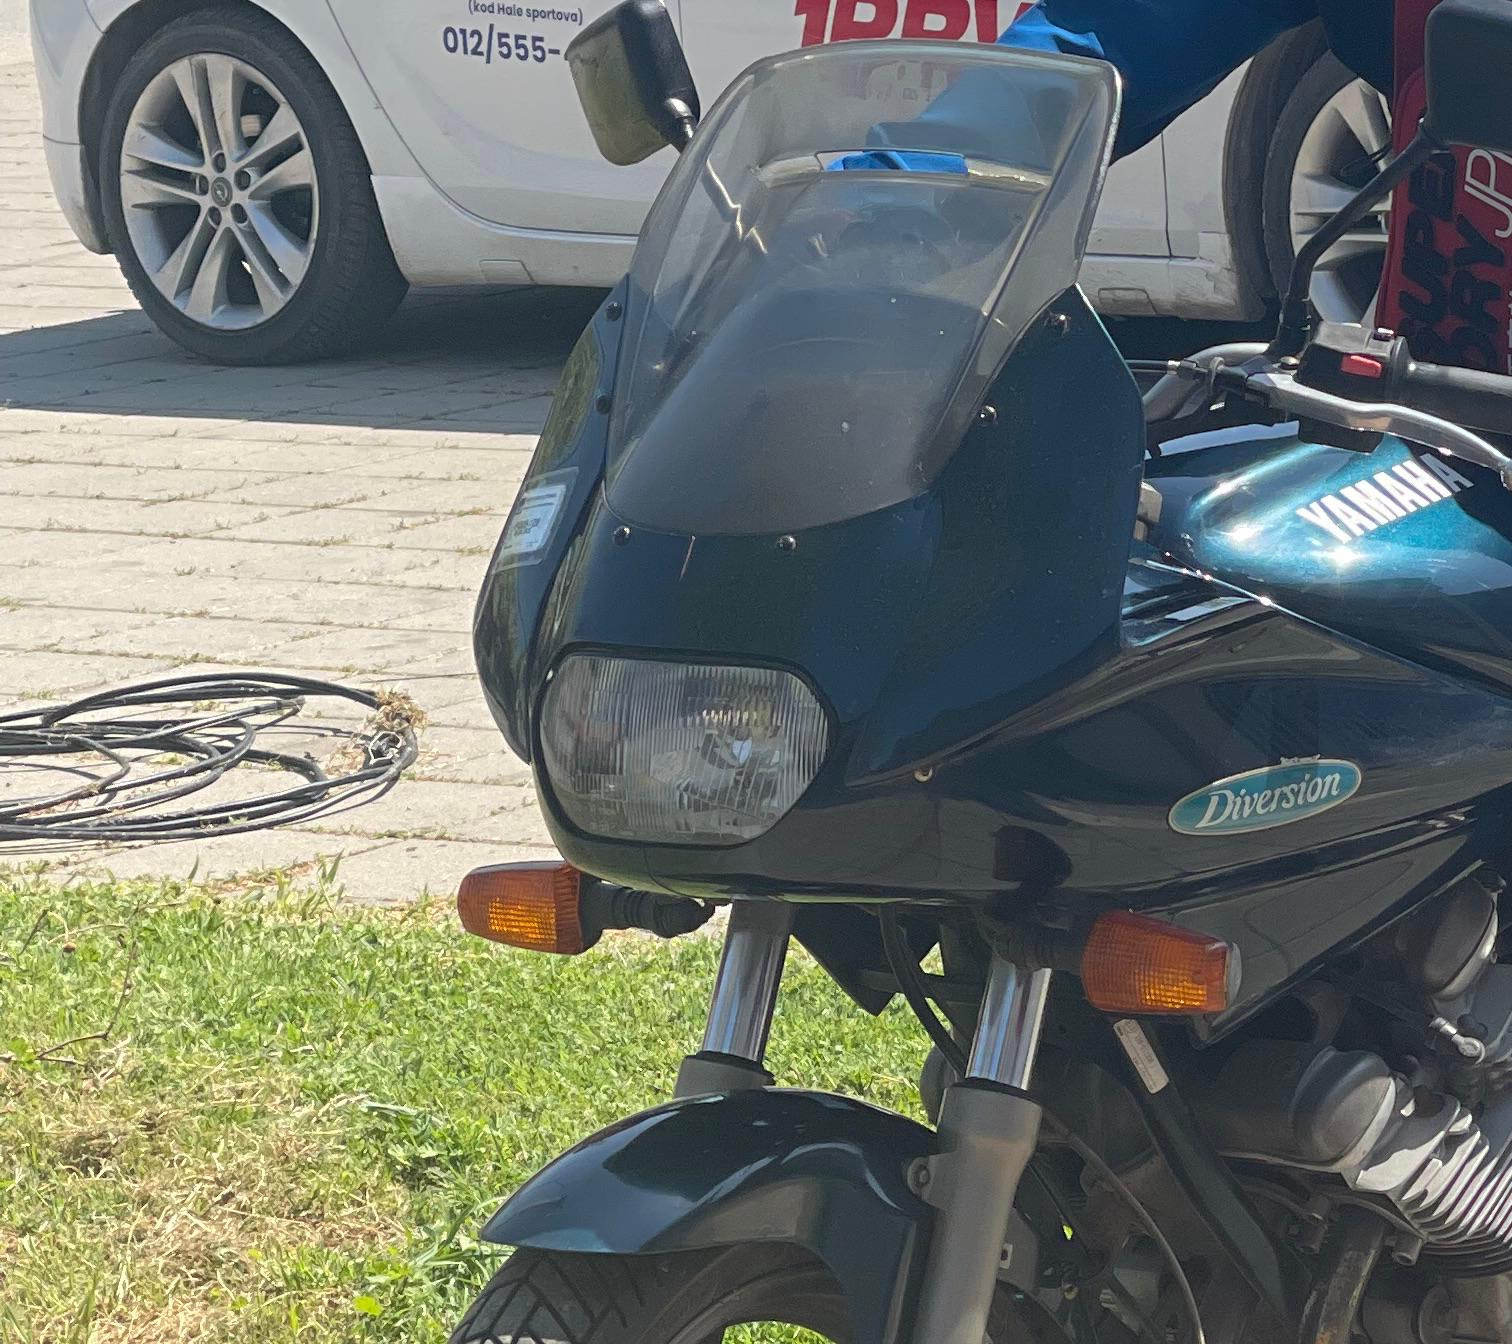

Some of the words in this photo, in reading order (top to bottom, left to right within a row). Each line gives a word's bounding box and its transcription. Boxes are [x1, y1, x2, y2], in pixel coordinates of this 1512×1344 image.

[497, 1, 523, 18] Hale
[525, 6, 583, 26] sportova)
[442, 23, 561, 64] 012/555-
[1295, 453, 1475, 544] YAMAHA
[1194, 772, 1341, 829] Diversion
